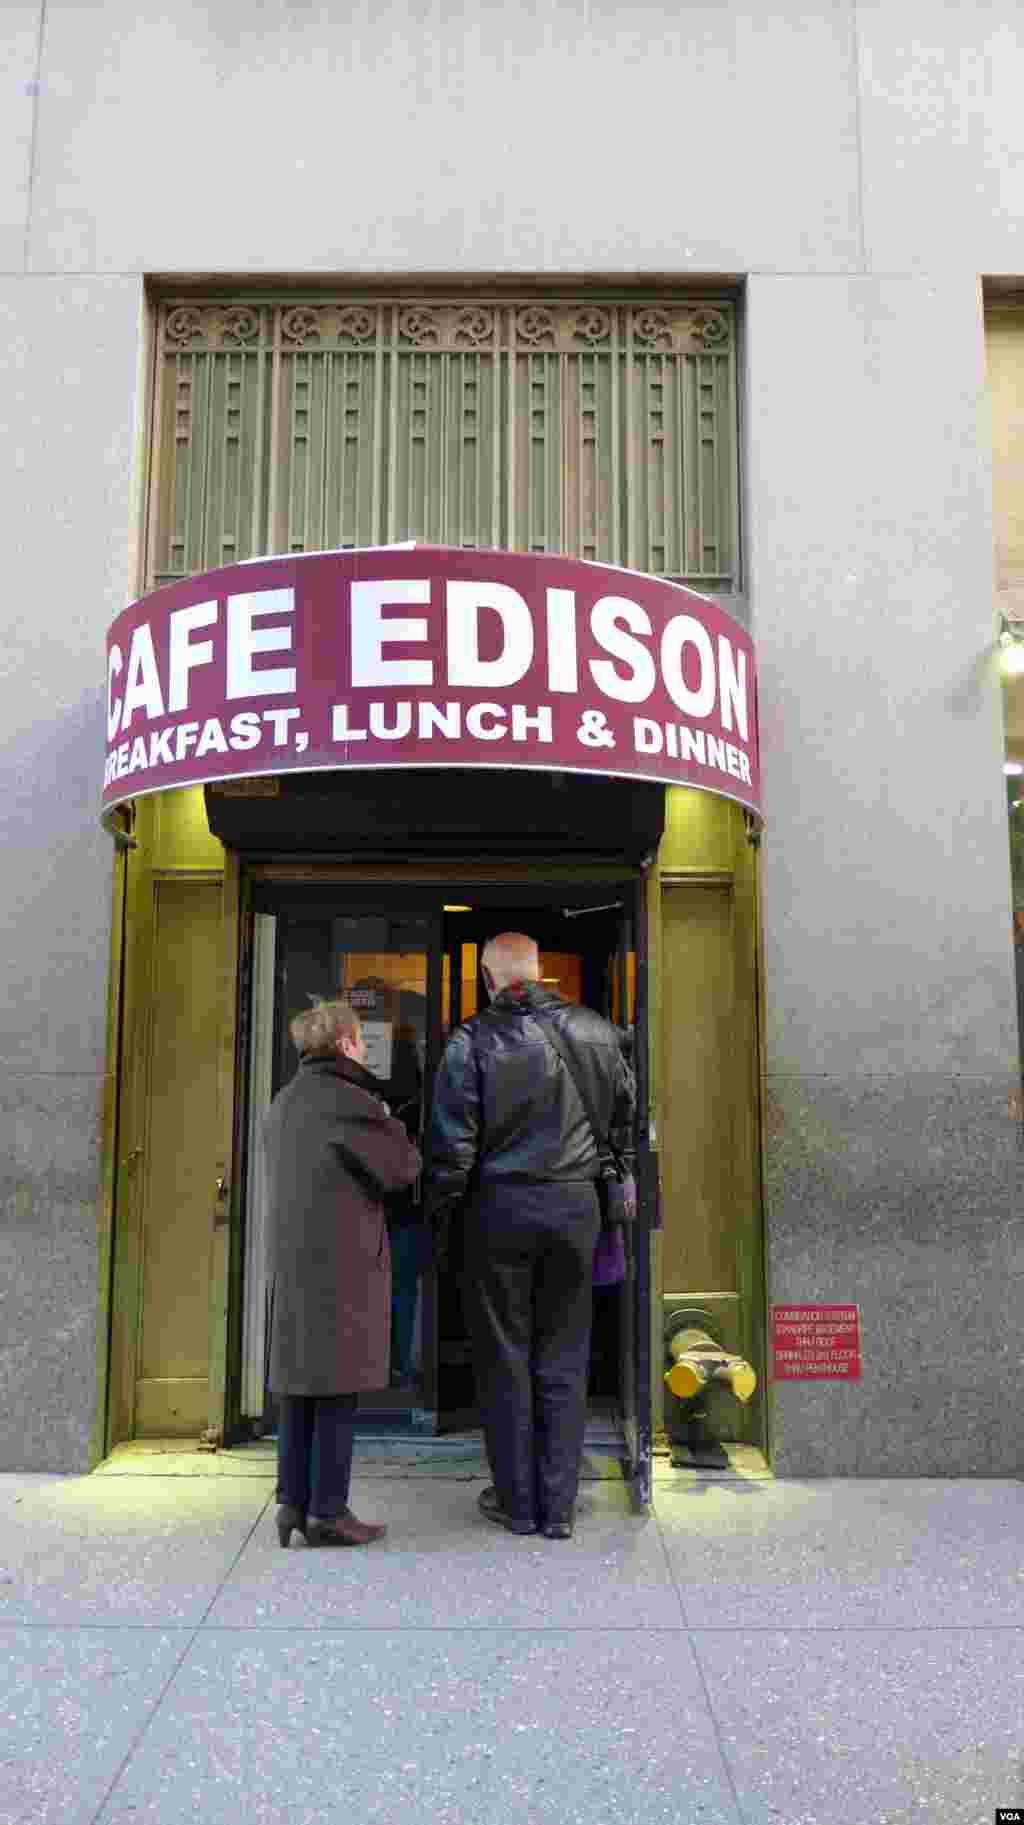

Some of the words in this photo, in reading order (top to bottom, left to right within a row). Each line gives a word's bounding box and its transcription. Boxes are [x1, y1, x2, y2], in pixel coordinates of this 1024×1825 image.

[108, 588, 296, 742] CAFE
[350, 578, 749, 742] EDISON
[333, 702, 553, 742] LUNCH
[577, 709, 616, 748] &
[633, 716, 752, 786] DINNER
